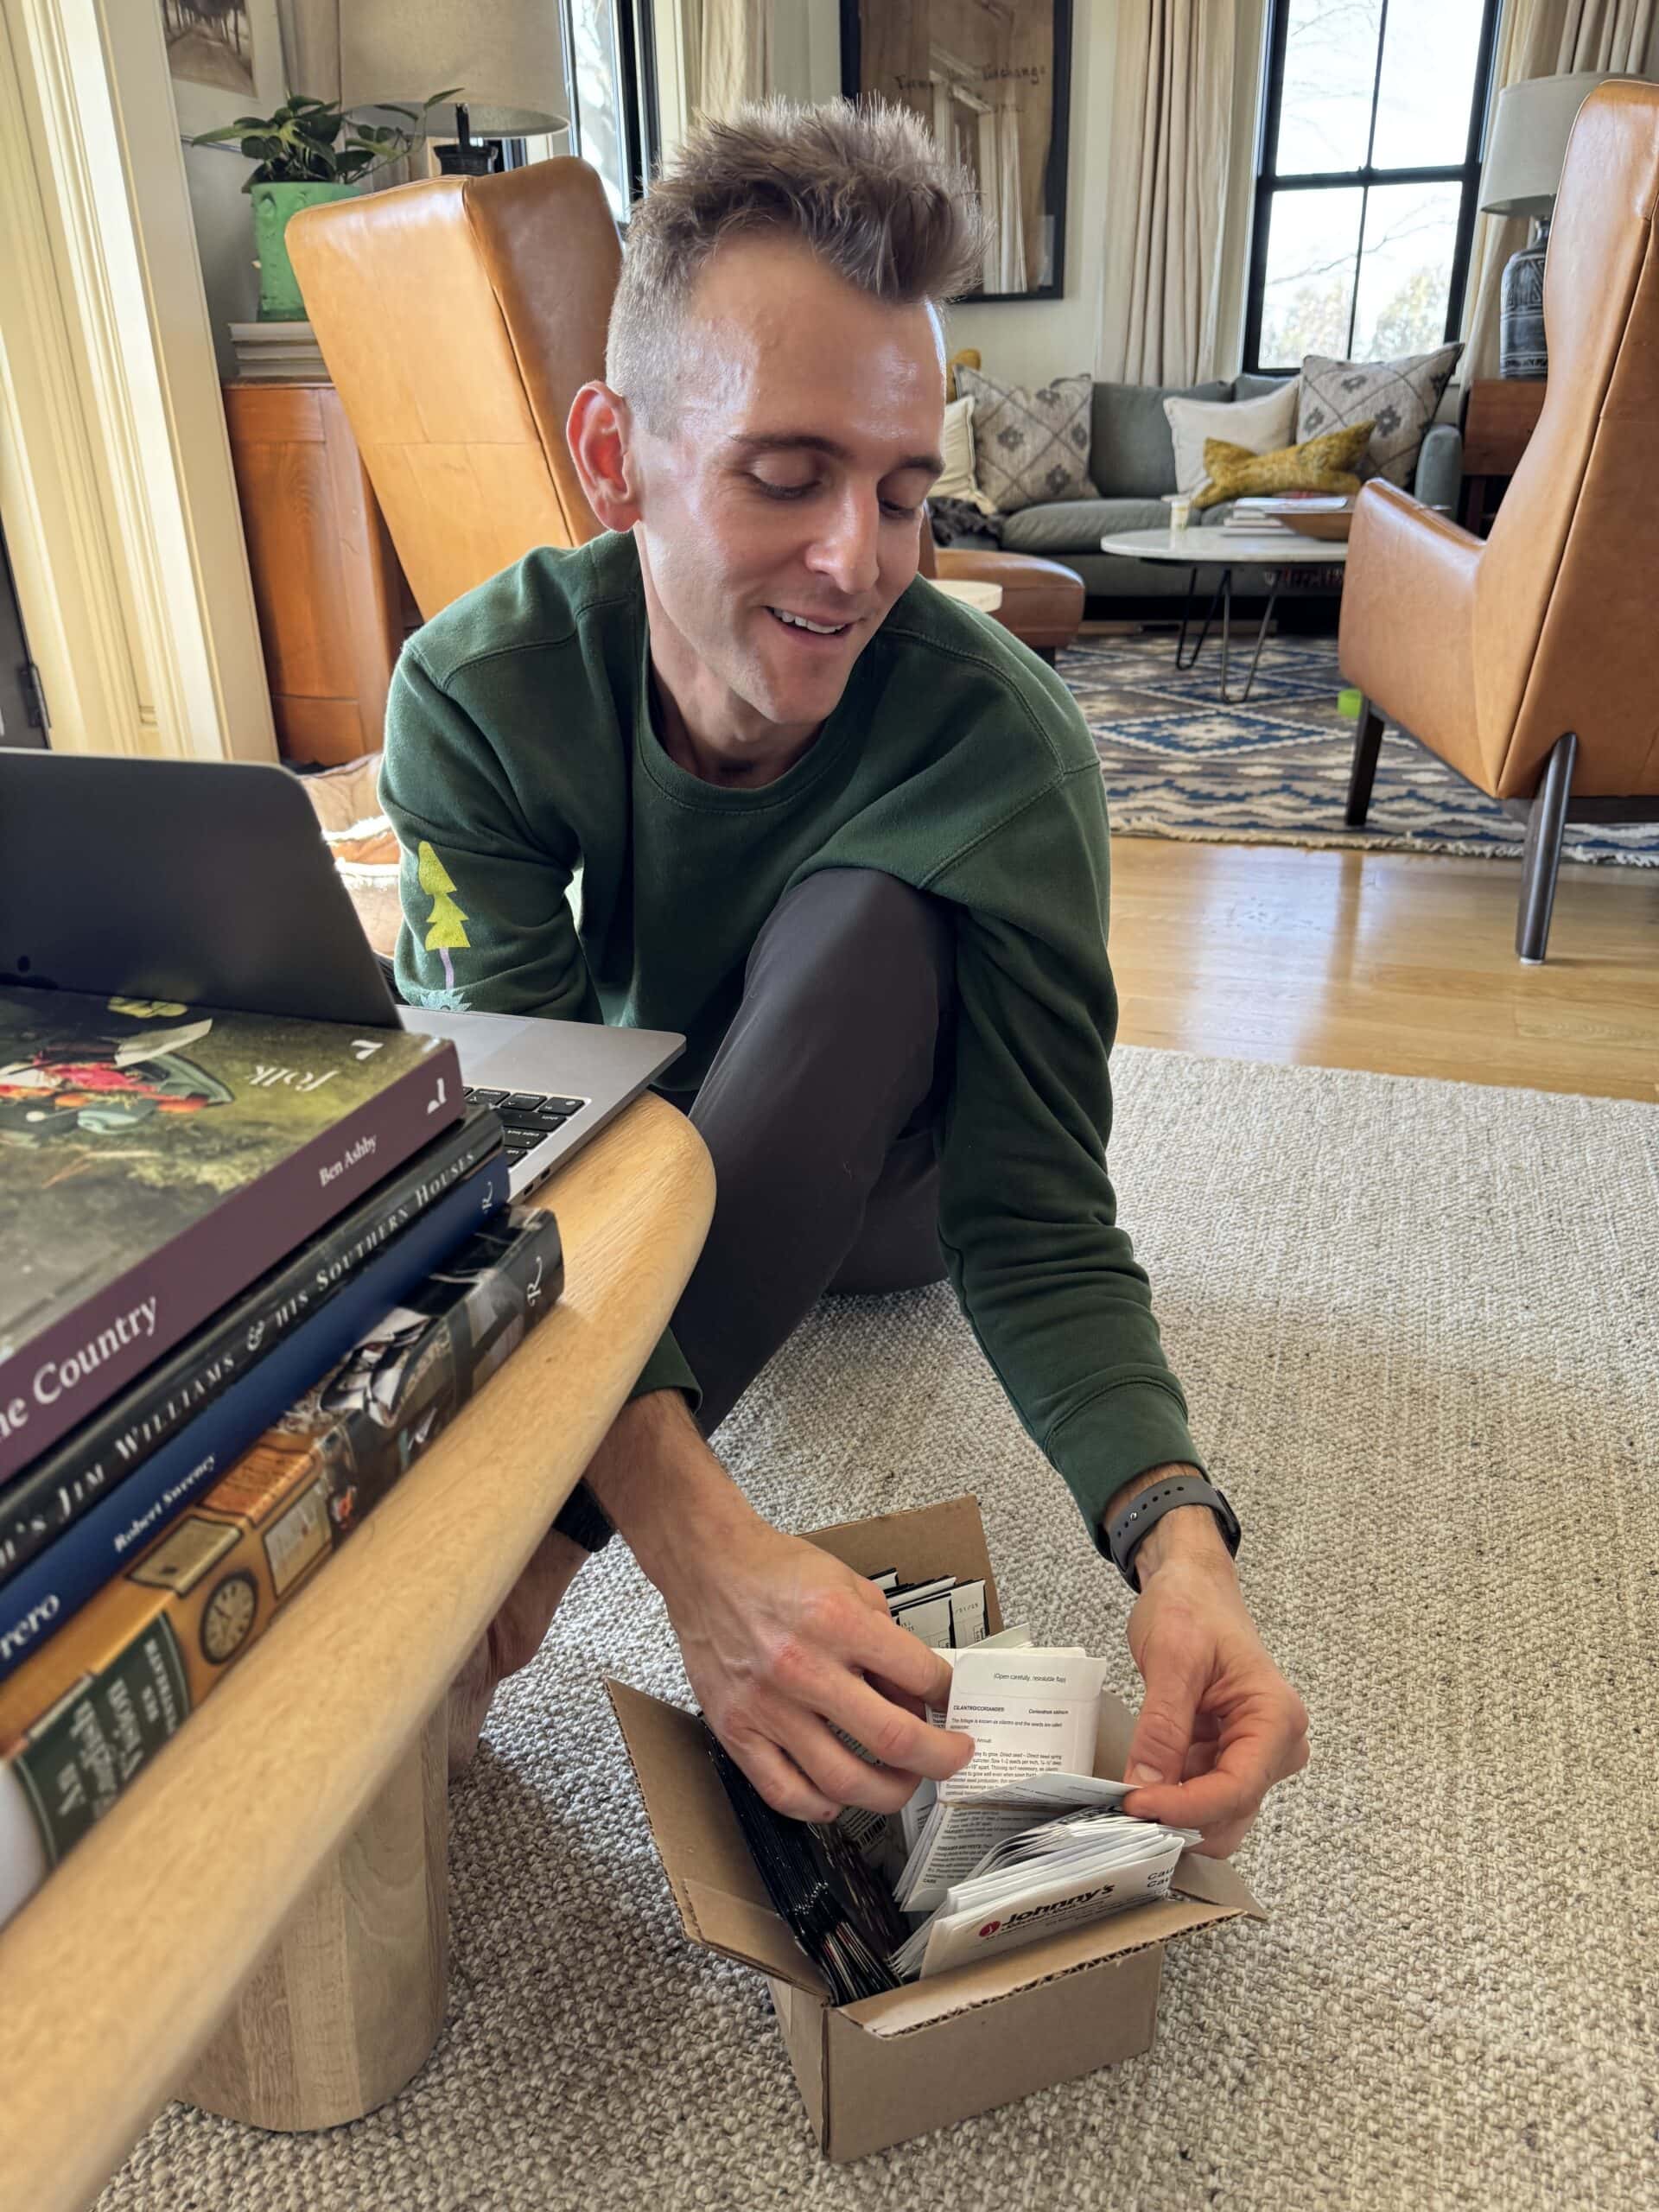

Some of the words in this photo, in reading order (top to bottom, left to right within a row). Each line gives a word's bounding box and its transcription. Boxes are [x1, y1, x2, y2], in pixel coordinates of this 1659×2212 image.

[318, 1160, 343, 1188] Ben
[345, 1135, 377, 1168] Ashby
[33, 1295, 156, 1405] Country
[246, 1320, 265, 1351] &
[113, 1502, 162, 1553] Robert
[162, 1454, 215, 1509] Sweeney
[1001, 1883, 1116, 1926] Johnny's
